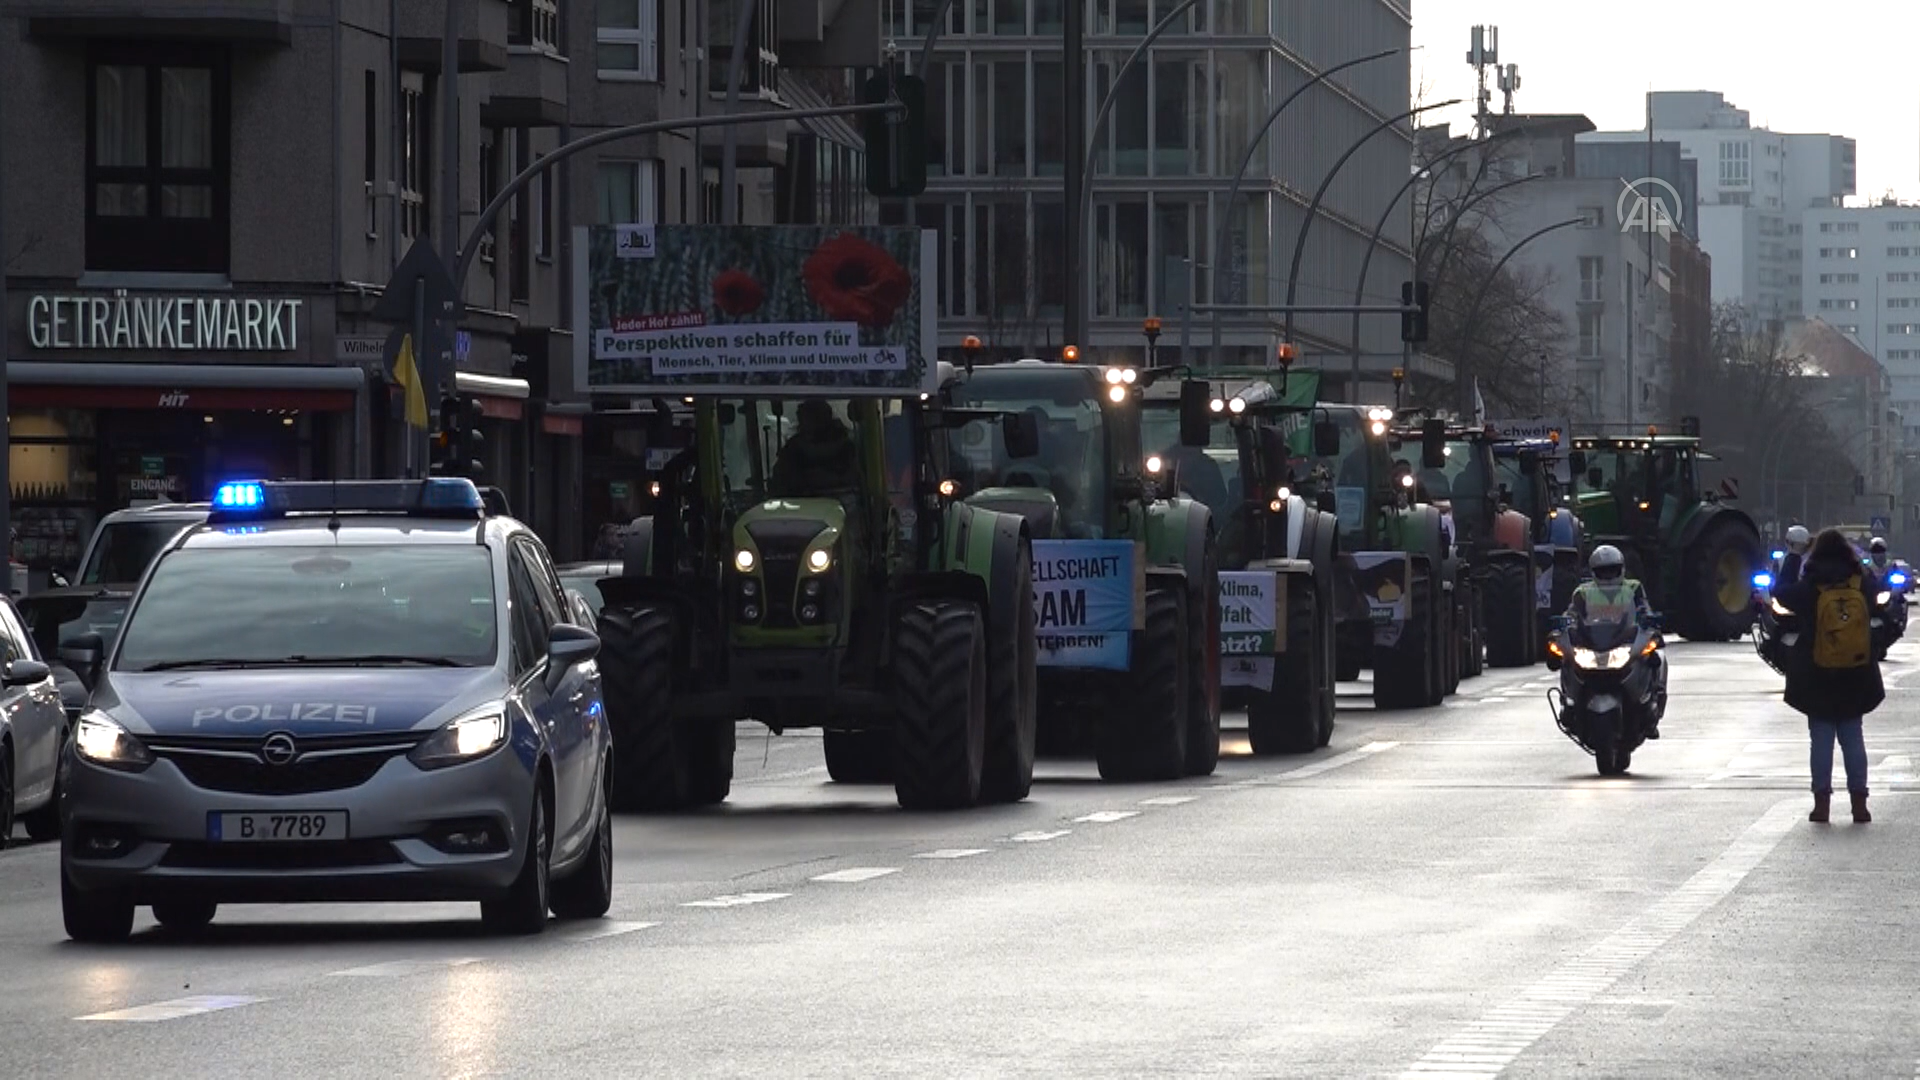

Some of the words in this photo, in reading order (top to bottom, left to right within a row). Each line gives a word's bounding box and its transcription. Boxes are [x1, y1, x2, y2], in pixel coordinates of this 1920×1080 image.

[29, 288, 303, 350] GETRÄNKEMARKT
[615, 319, 647, 331] Jeder
[649, 317, 669, 328] Hof
[671, 314, 702, 325] zählt!
[603, 333, 728, 353] Perspektiven
[733, 331, 819, 348] schaffen
[823, 329, 852, 347] für
[658, 355, 715, 368] Mensch,
[717, 355, 746, 367] Tier,
[749, 354, 787, 366] Klima
[790, 353, 816, 365] und
[818, 353, 868, 365] Umwelt
[158, 390, 190, 407] HIT
[130, 479, 176, 491] EINGANG
[192, 703, 377, 728] POLIZEI
[241, 816, 255, 838] B
[270, 815, 326, 838] 7789
